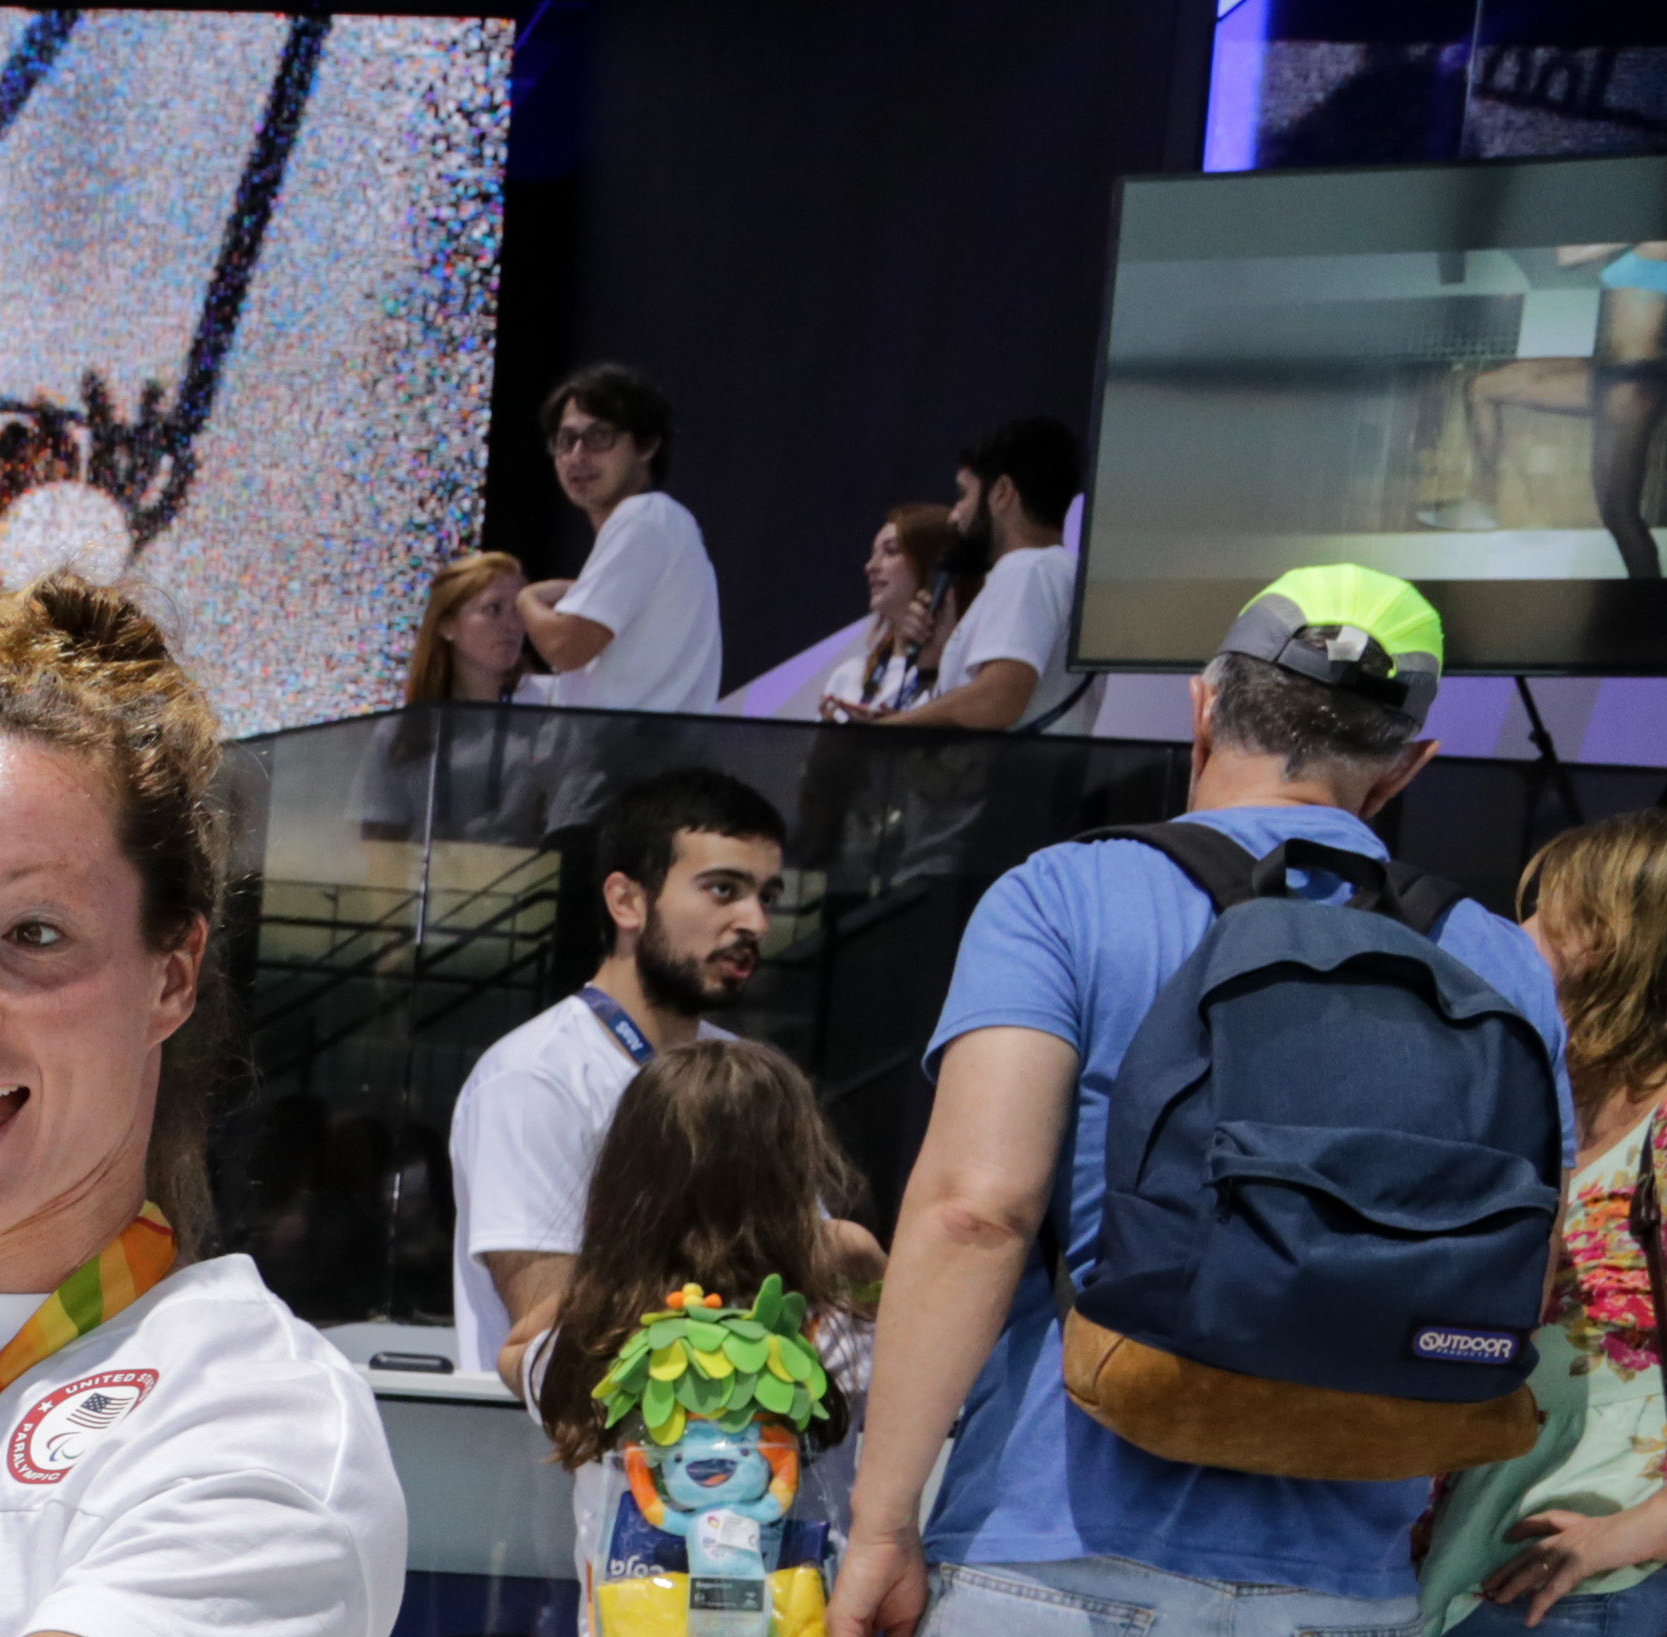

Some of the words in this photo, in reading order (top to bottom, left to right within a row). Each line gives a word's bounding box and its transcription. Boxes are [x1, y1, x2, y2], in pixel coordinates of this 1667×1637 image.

[1419, 1331, 1513, 1358] OUTDOOR
[64, 1372, 136, 1395] UNITED
[12, 1422, 61, 1481] PARALYMPIC
